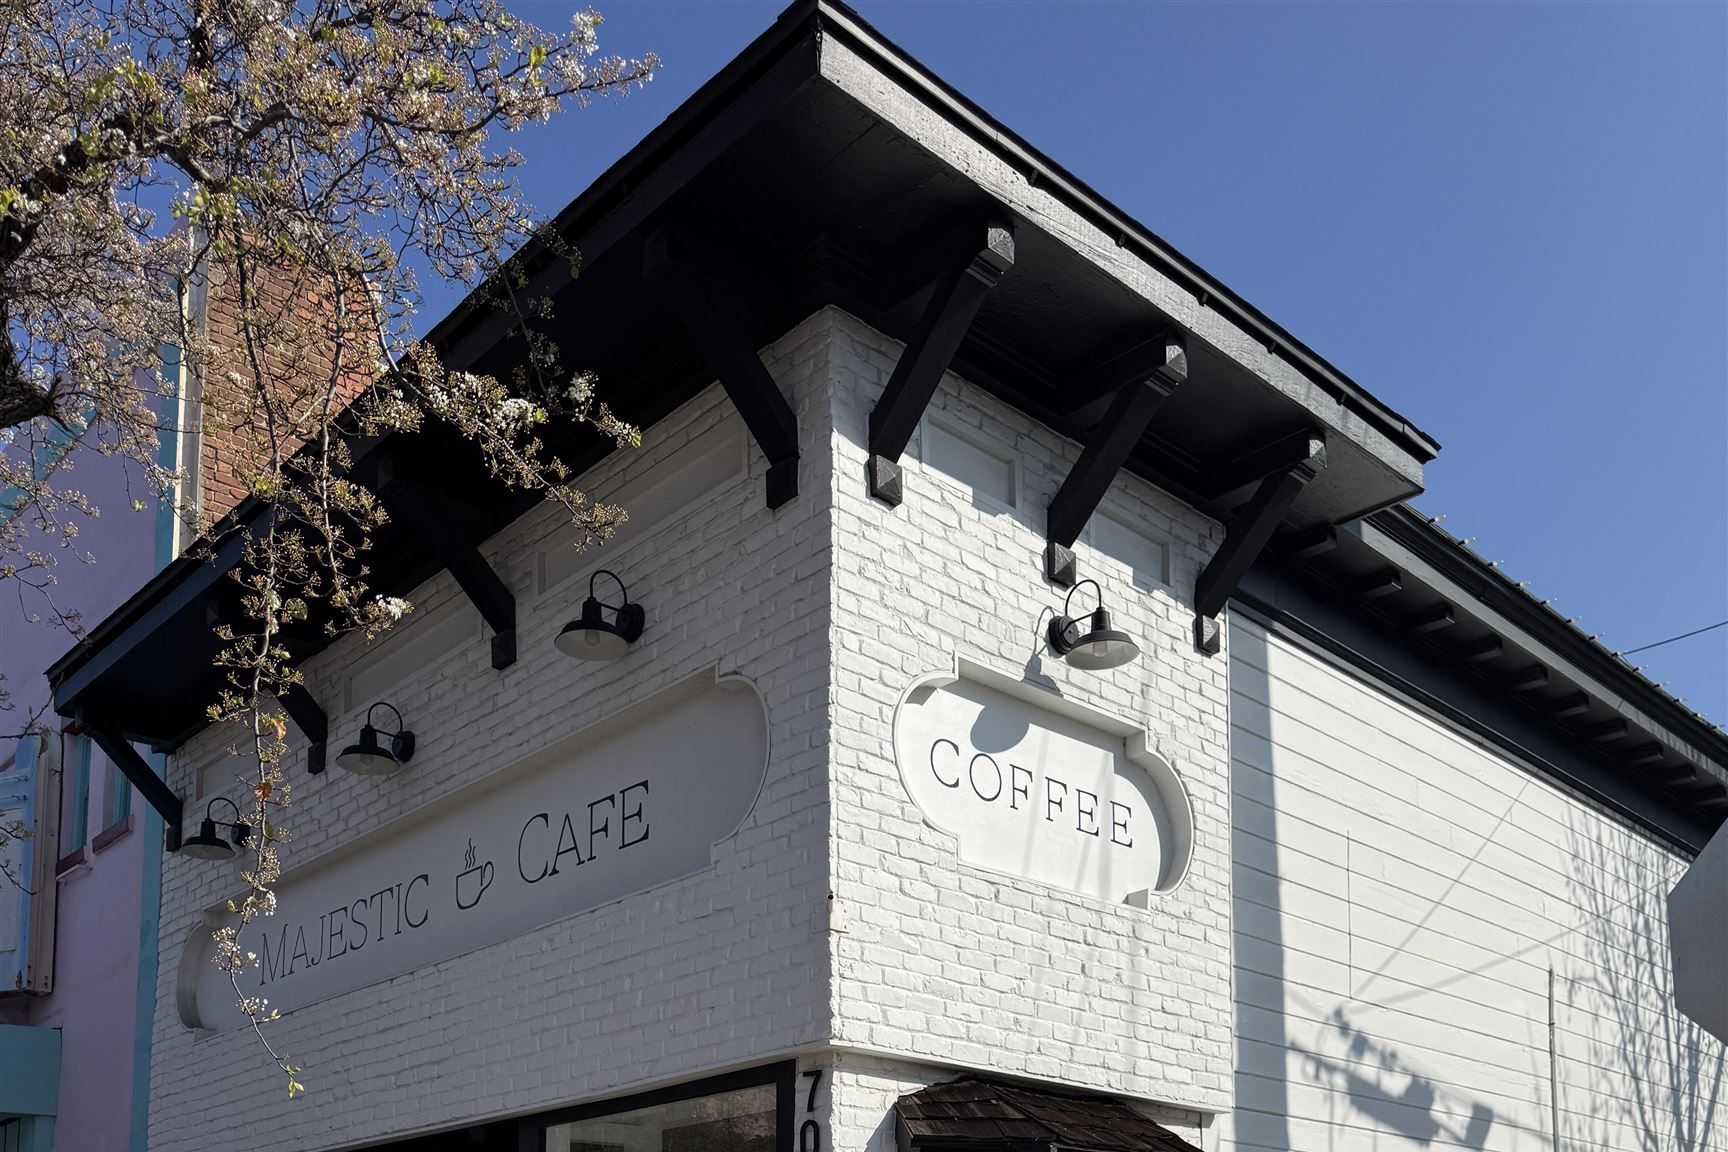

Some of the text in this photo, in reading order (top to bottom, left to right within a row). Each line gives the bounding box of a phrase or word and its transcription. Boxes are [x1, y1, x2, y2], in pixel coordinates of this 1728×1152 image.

[930, 738, 1133, 848] COFFEE
[259, 779, 650, 986] MAJESTIC CAFE
